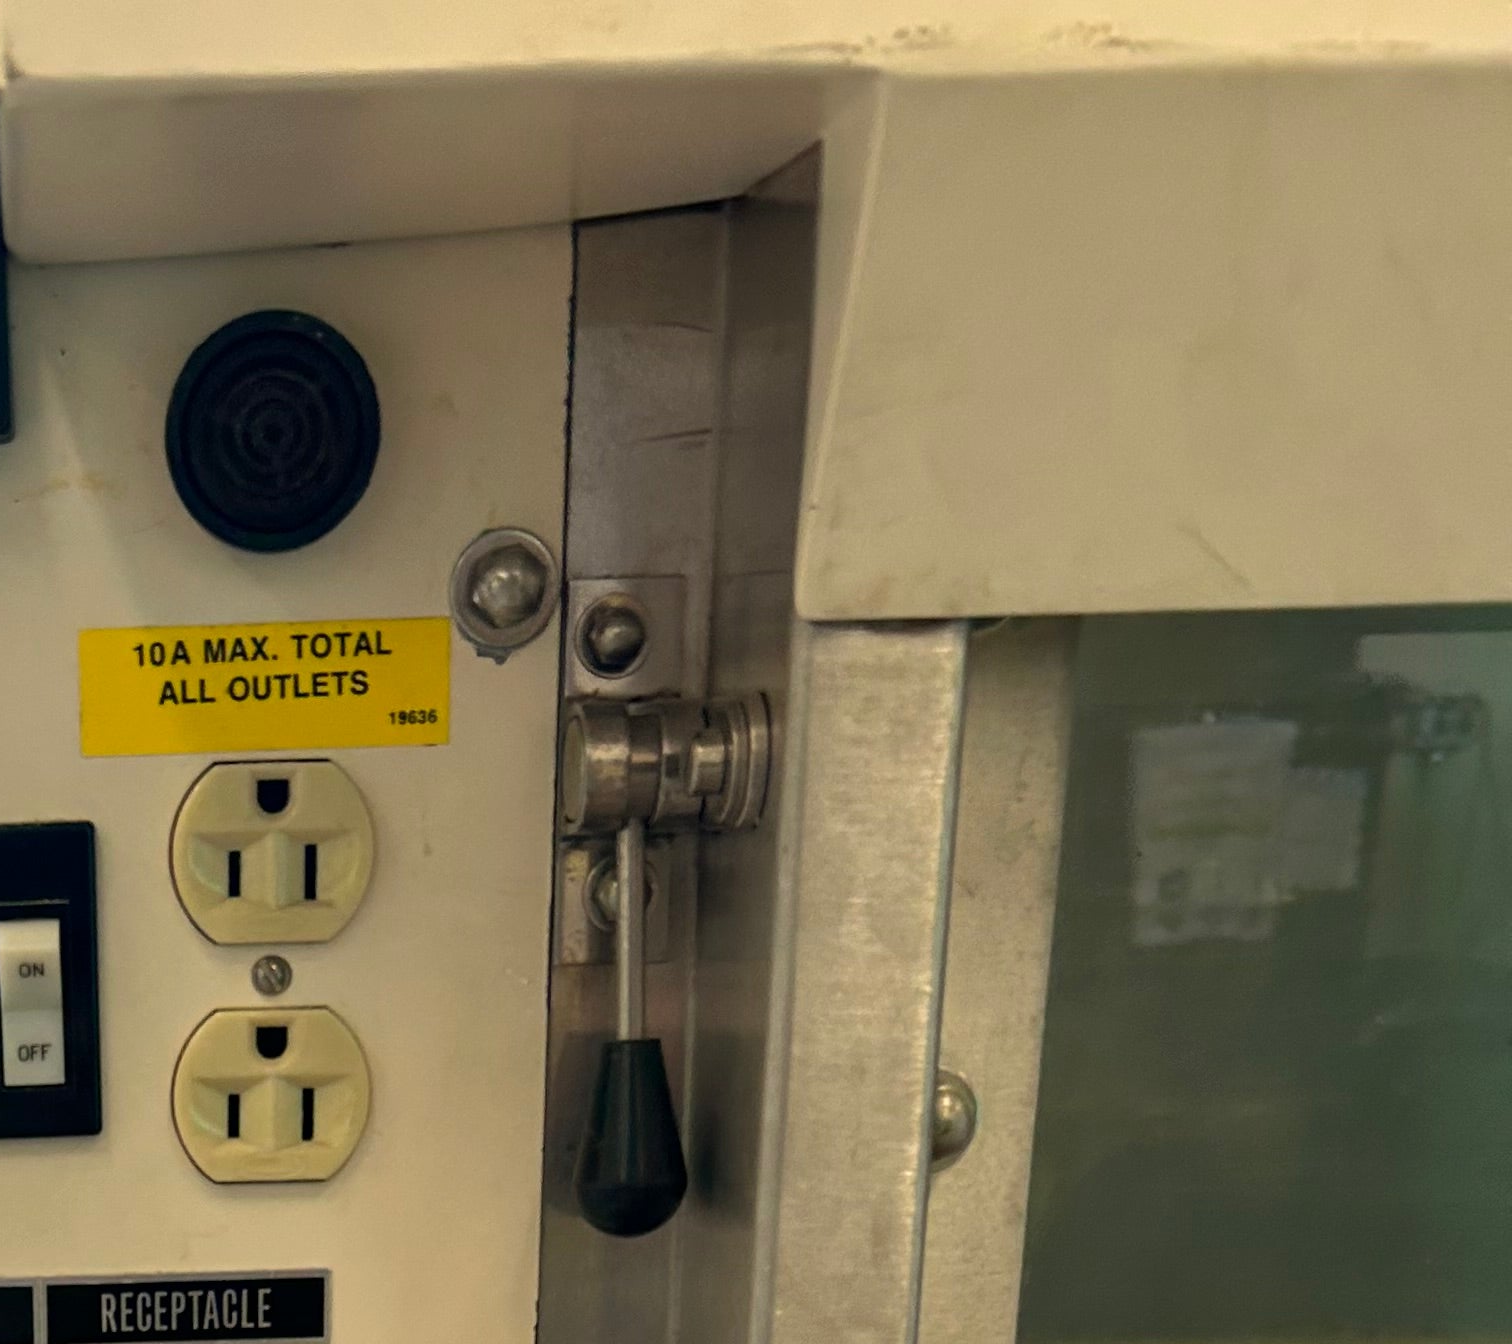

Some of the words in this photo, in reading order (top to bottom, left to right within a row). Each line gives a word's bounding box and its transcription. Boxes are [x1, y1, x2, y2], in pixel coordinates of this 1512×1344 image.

[203, 635, 278, 664] MAX.
[290, 630, 392, 659] TOTAL
[158, 678, 215, 706] ALL
[227, 670, 369, 701] OUTLETS
[18, 962, 45, 978] ON
[17, 1044, 52, 1062] OFF
[99, 1288, 274, 1334] RECEPTACLE
